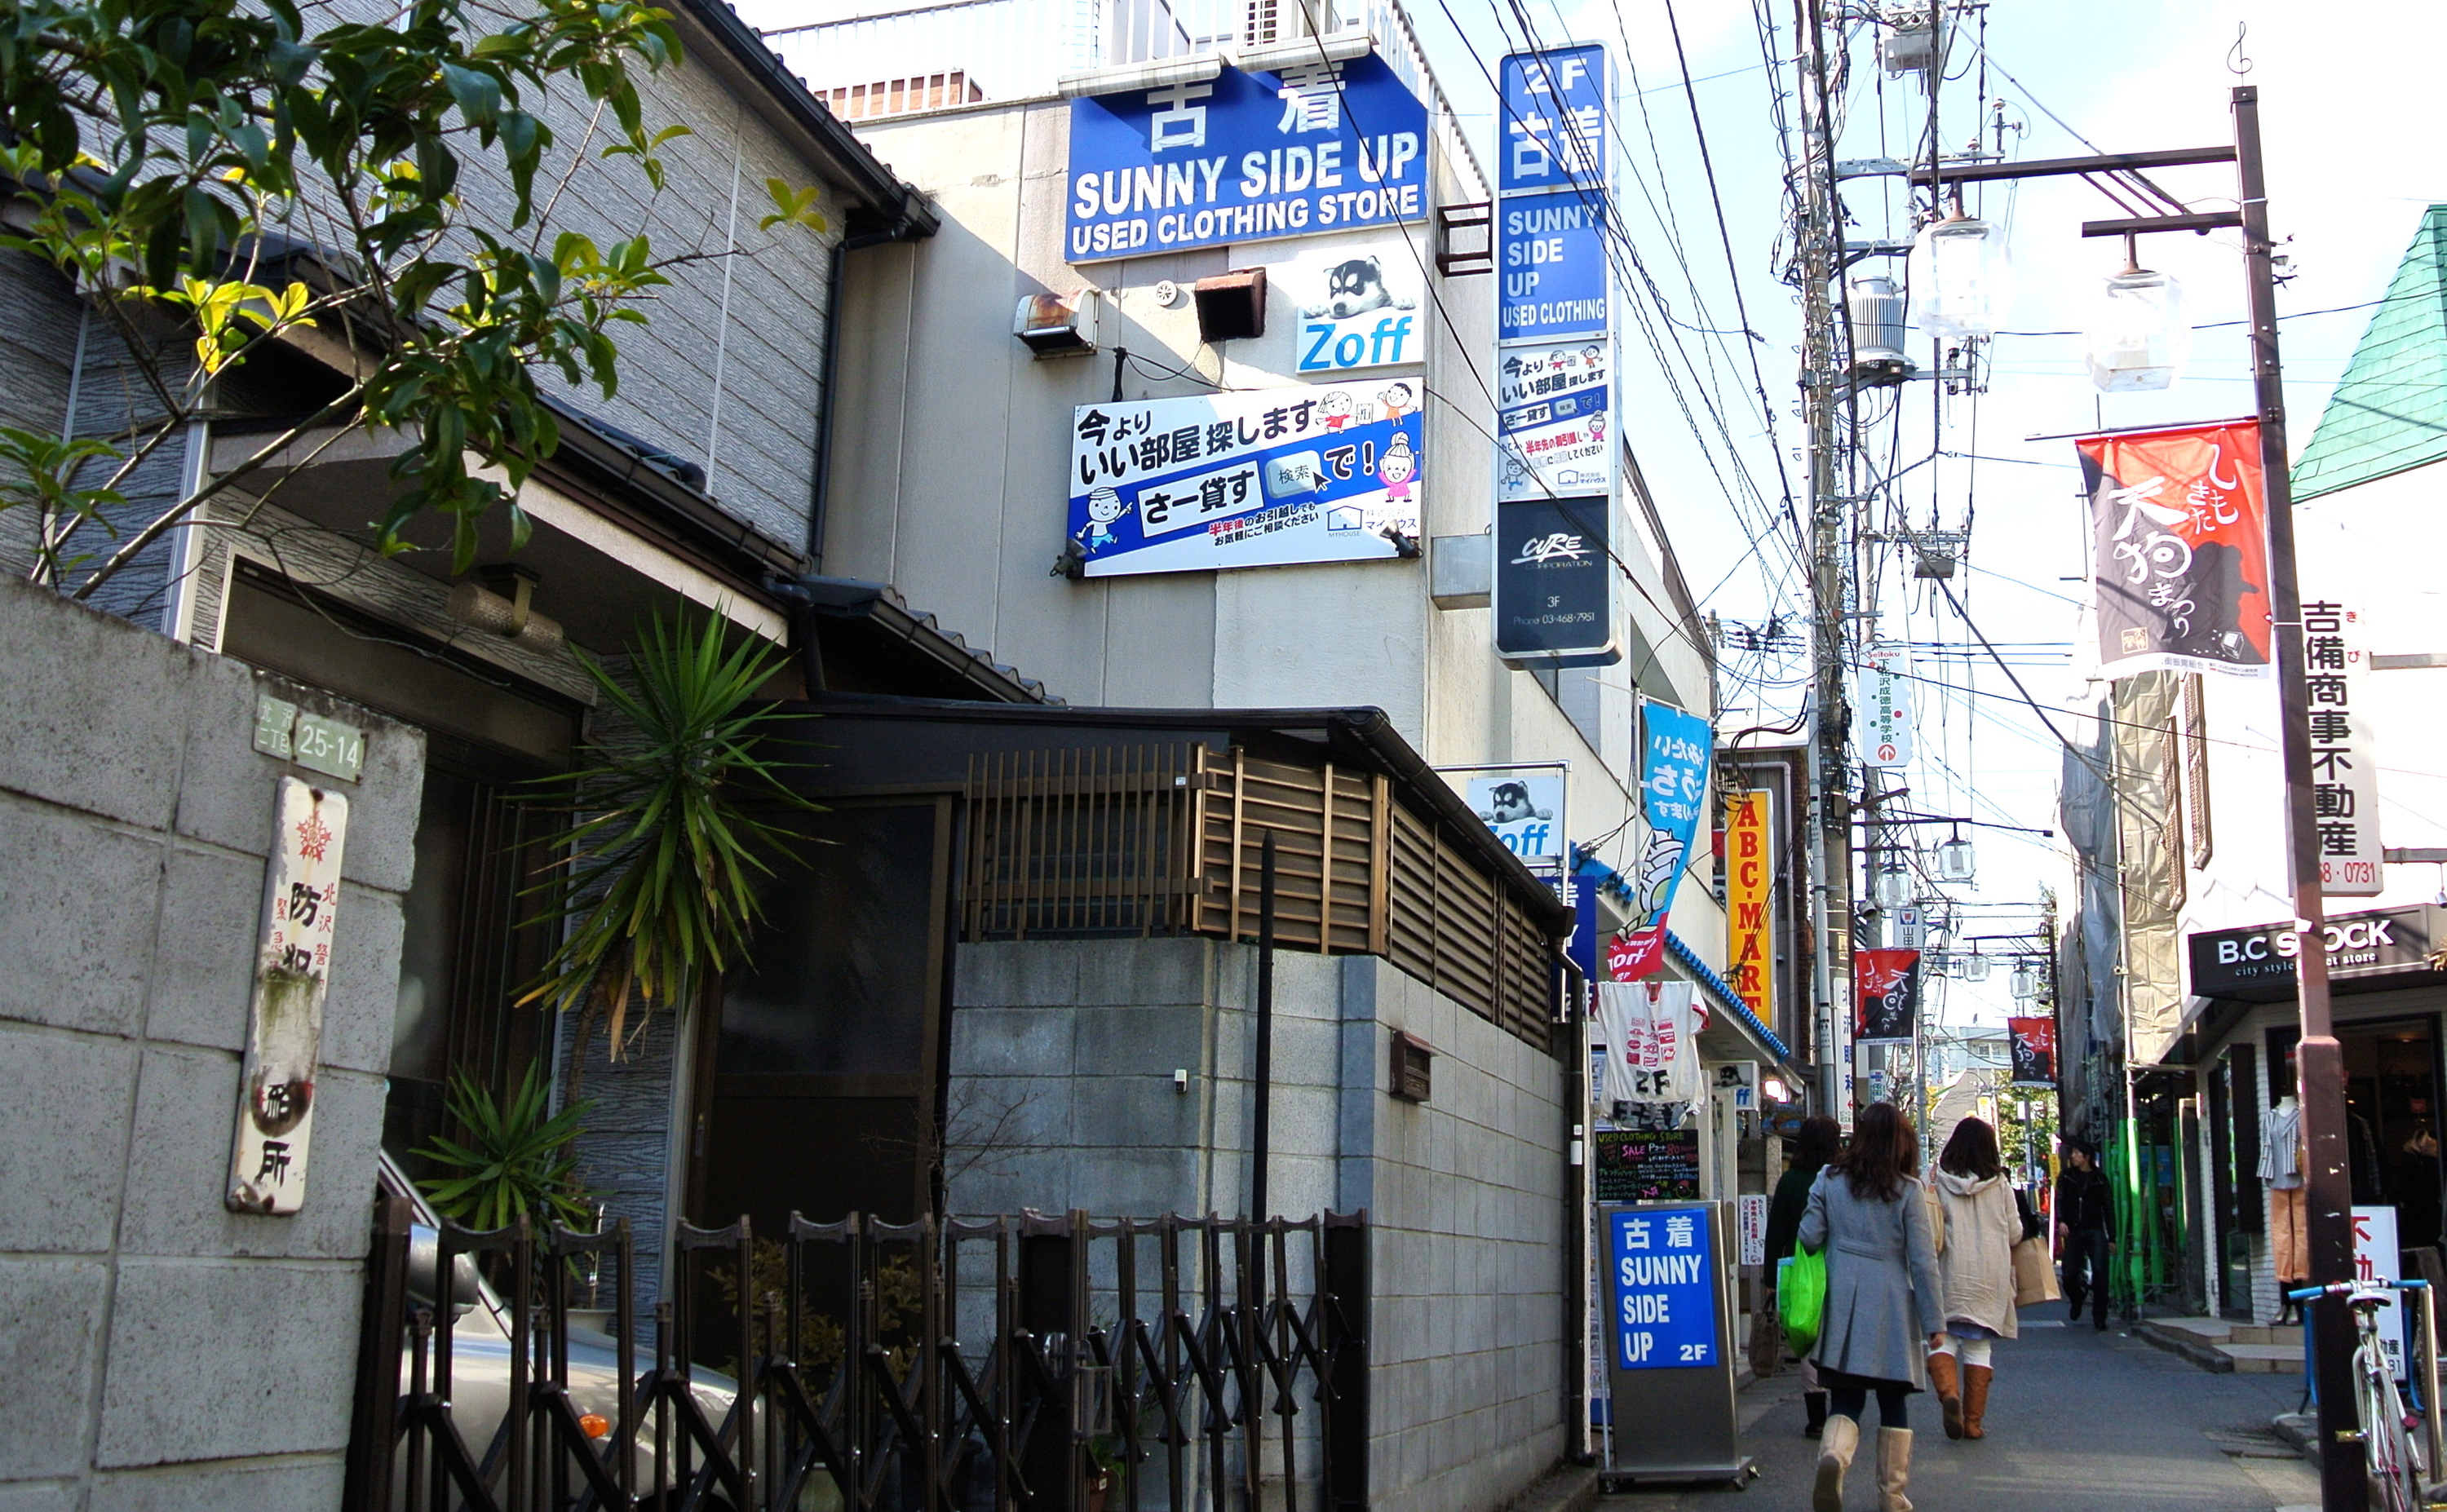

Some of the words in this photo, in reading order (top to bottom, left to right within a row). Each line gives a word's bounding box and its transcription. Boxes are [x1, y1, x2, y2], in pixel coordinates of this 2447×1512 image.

[1524, 58, 1586, 95] 2F
[1510, 104, 1601, 179] 古着
[1074, 156, 1227, 219] SUNNY
[1241, 141, 1343, 198] SIDE
[1358, 131, 1419, 183] UP
[1073, 219, 1148, 254] USED
[1157, 198, 1309, 245] CLOTHING
[1318, 184, 1419, 225] STORE
[1507, 203, 1602, 235] SUNNY
[1507, 237, 1564, 265] SIDE
[1507, 271, 1540, 298] UP
[1503, 304, 1537, 328] USED
[1540, 298, 1605, 325] CLOTHING
[1299, 316, 1412, 370] Zoff
[1502, 356, 1544, 378] 今より
[1077, 409, 1152, 446] 今より
[1080, 400, 1317, 484] いい部屋探します
[1278, 464, 1310, 486] 検索
[1365, 518, 1418, 530] マイウス
[1547, 596, 1561, 608] 3F
[1513, 617, 1540, 626] Phone
[259, 701, 294, 729] 北沢
[299, 724, 359, 768] 25-14
[2218, 936, 2268, 965] B.C
[2276, 919, 2395, 957] SOCK
[2236, 966, 2259, 977] city
[2264, 962, 2294, 974] style
[2343, 953, 2377, 965] store
[1622, 1144, 1646, 1157] SALE
[1622, 1254, 1702, 1286] SUNNY
[1623, 1294, 1670, 1324] SIDE
[1625, 1332, 1653, 1362] UP
[1679, 1344, 1707, 1361] 2F
